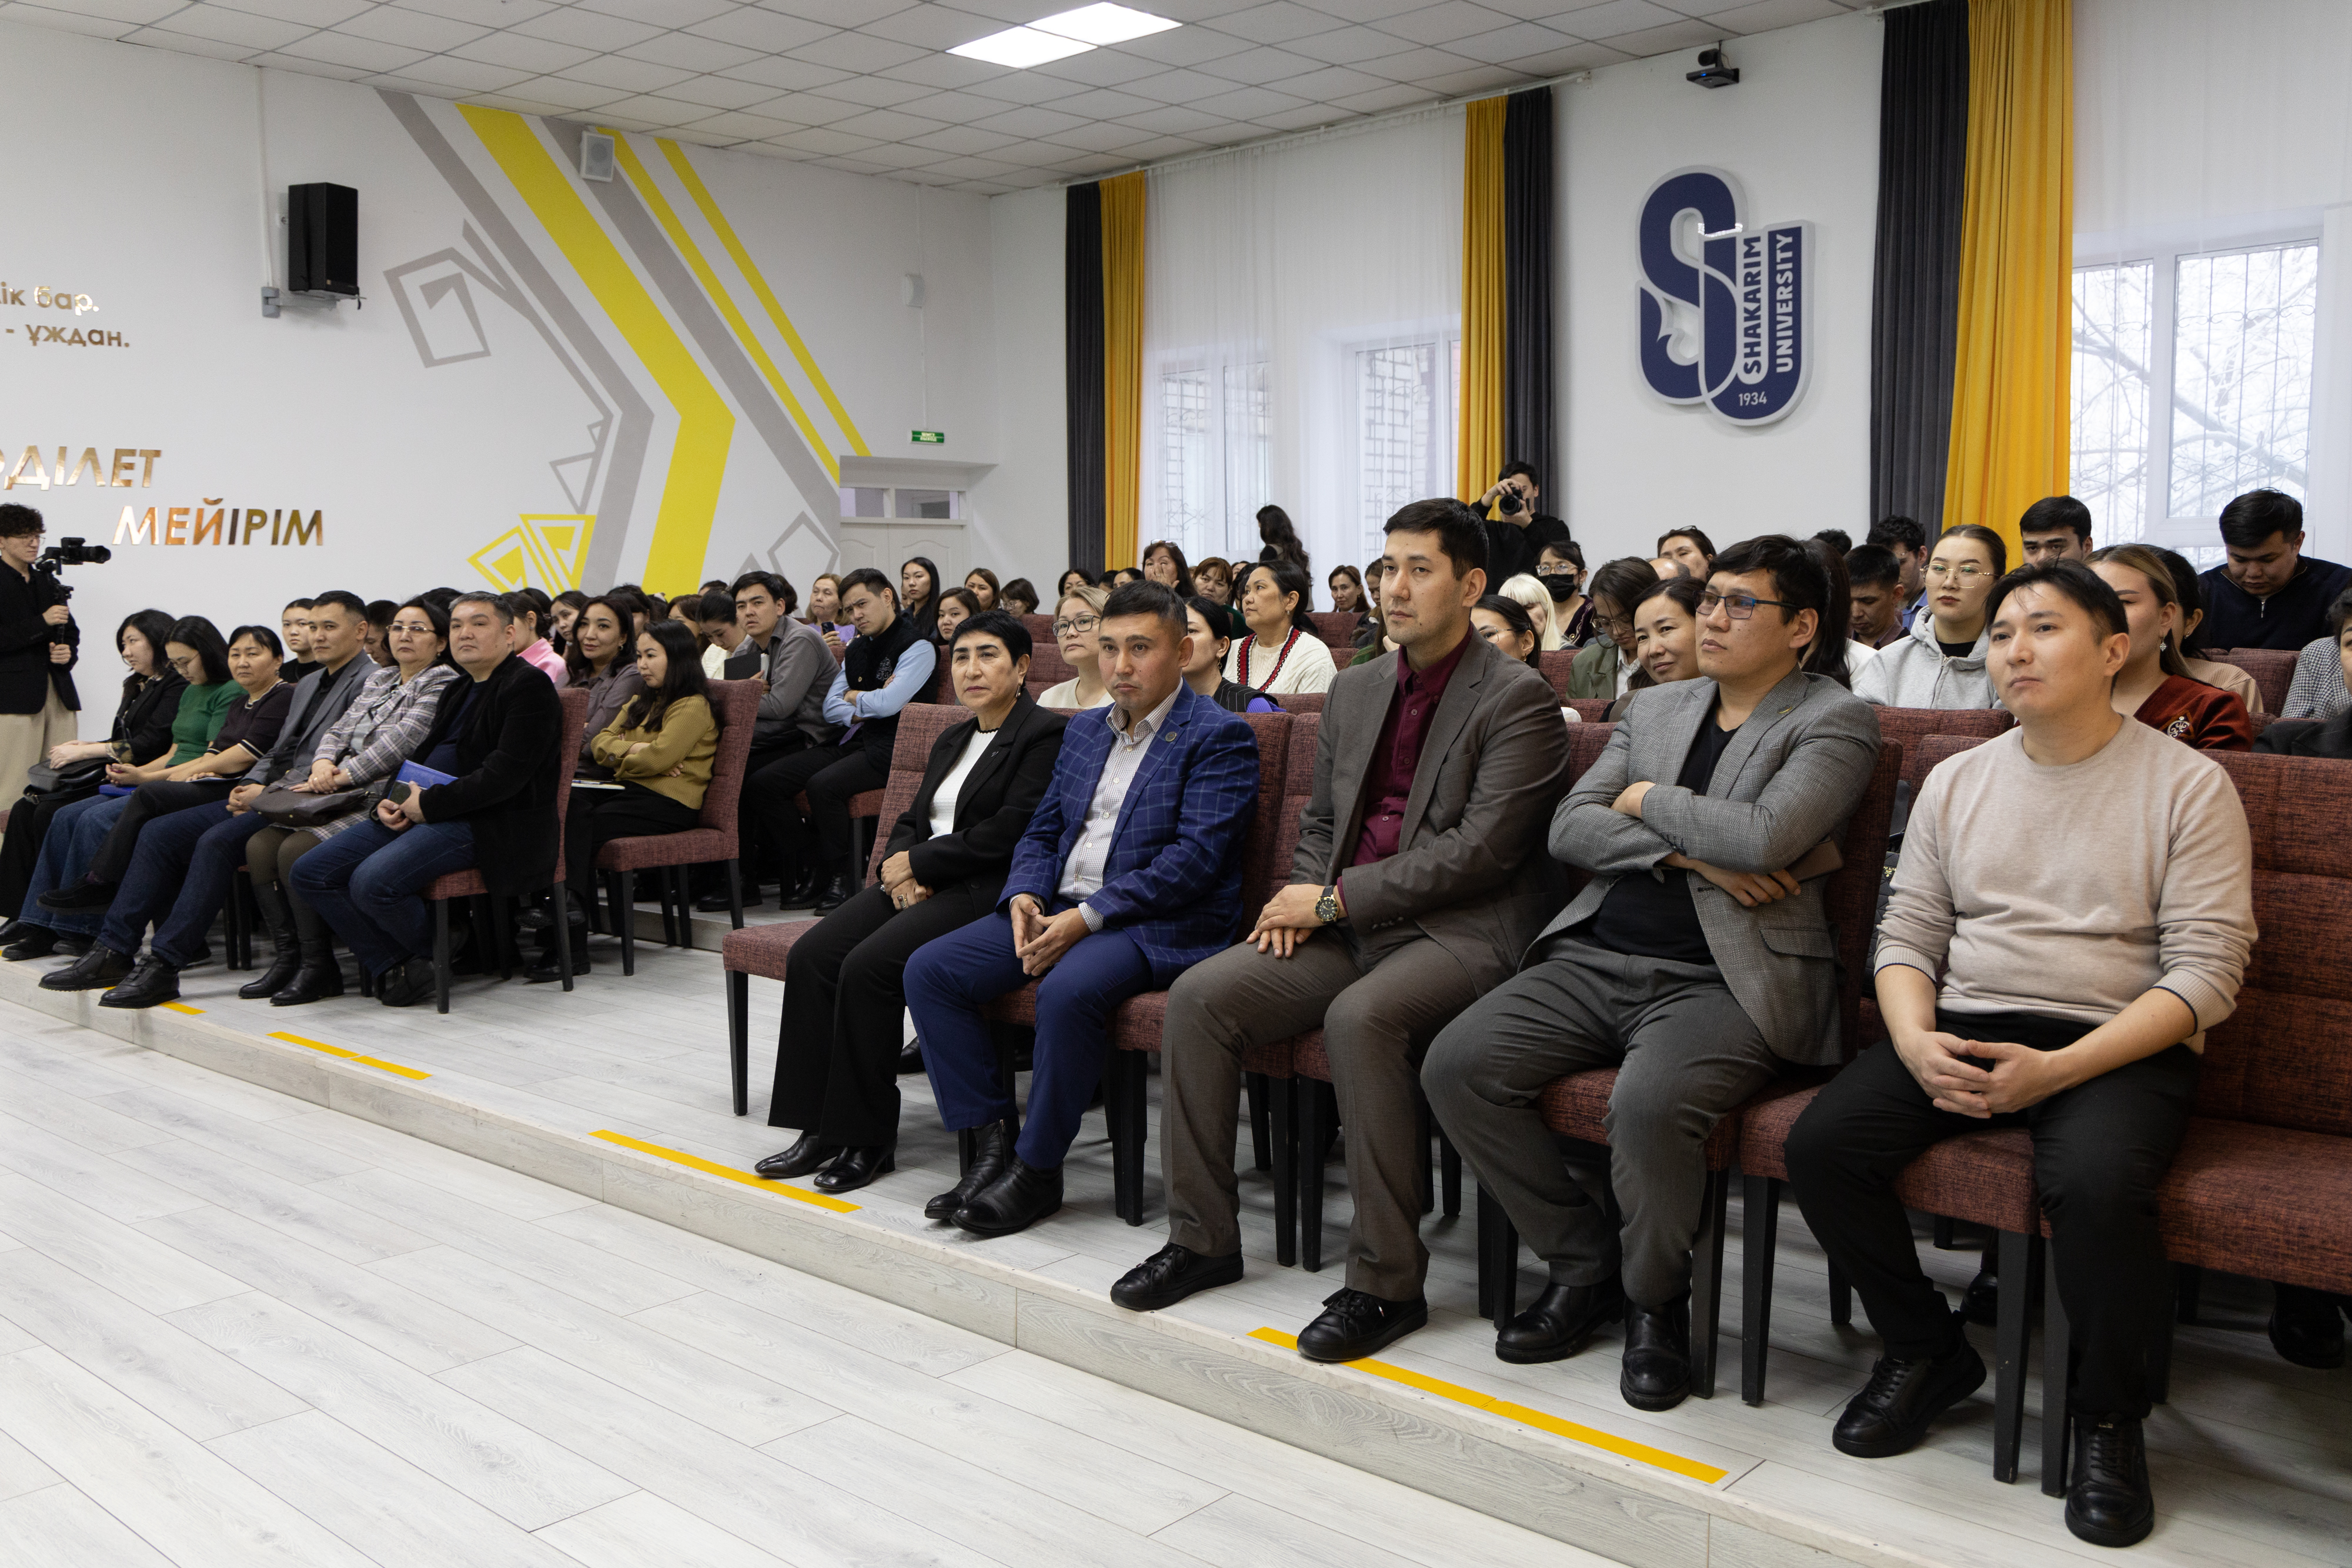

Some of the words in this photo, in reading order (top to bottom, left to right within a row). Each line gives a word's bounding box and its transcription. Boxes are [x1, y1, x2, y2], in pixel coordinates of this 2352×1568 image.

[0, 282, 26, 306] ік
[34, 286, 99, 316] бар.
[1743, 236, 1761, 374] SHAKARIM
[1776, 234, 1793, 373] UNIVERSITY
[25, 324, 129, 347] ұждан.
[1738, 391, 1767, 406] 1934
[0, 445, 162, 491] ДІЛЕТ
[112, 497, 323, 546] МЕЙІРІМ
